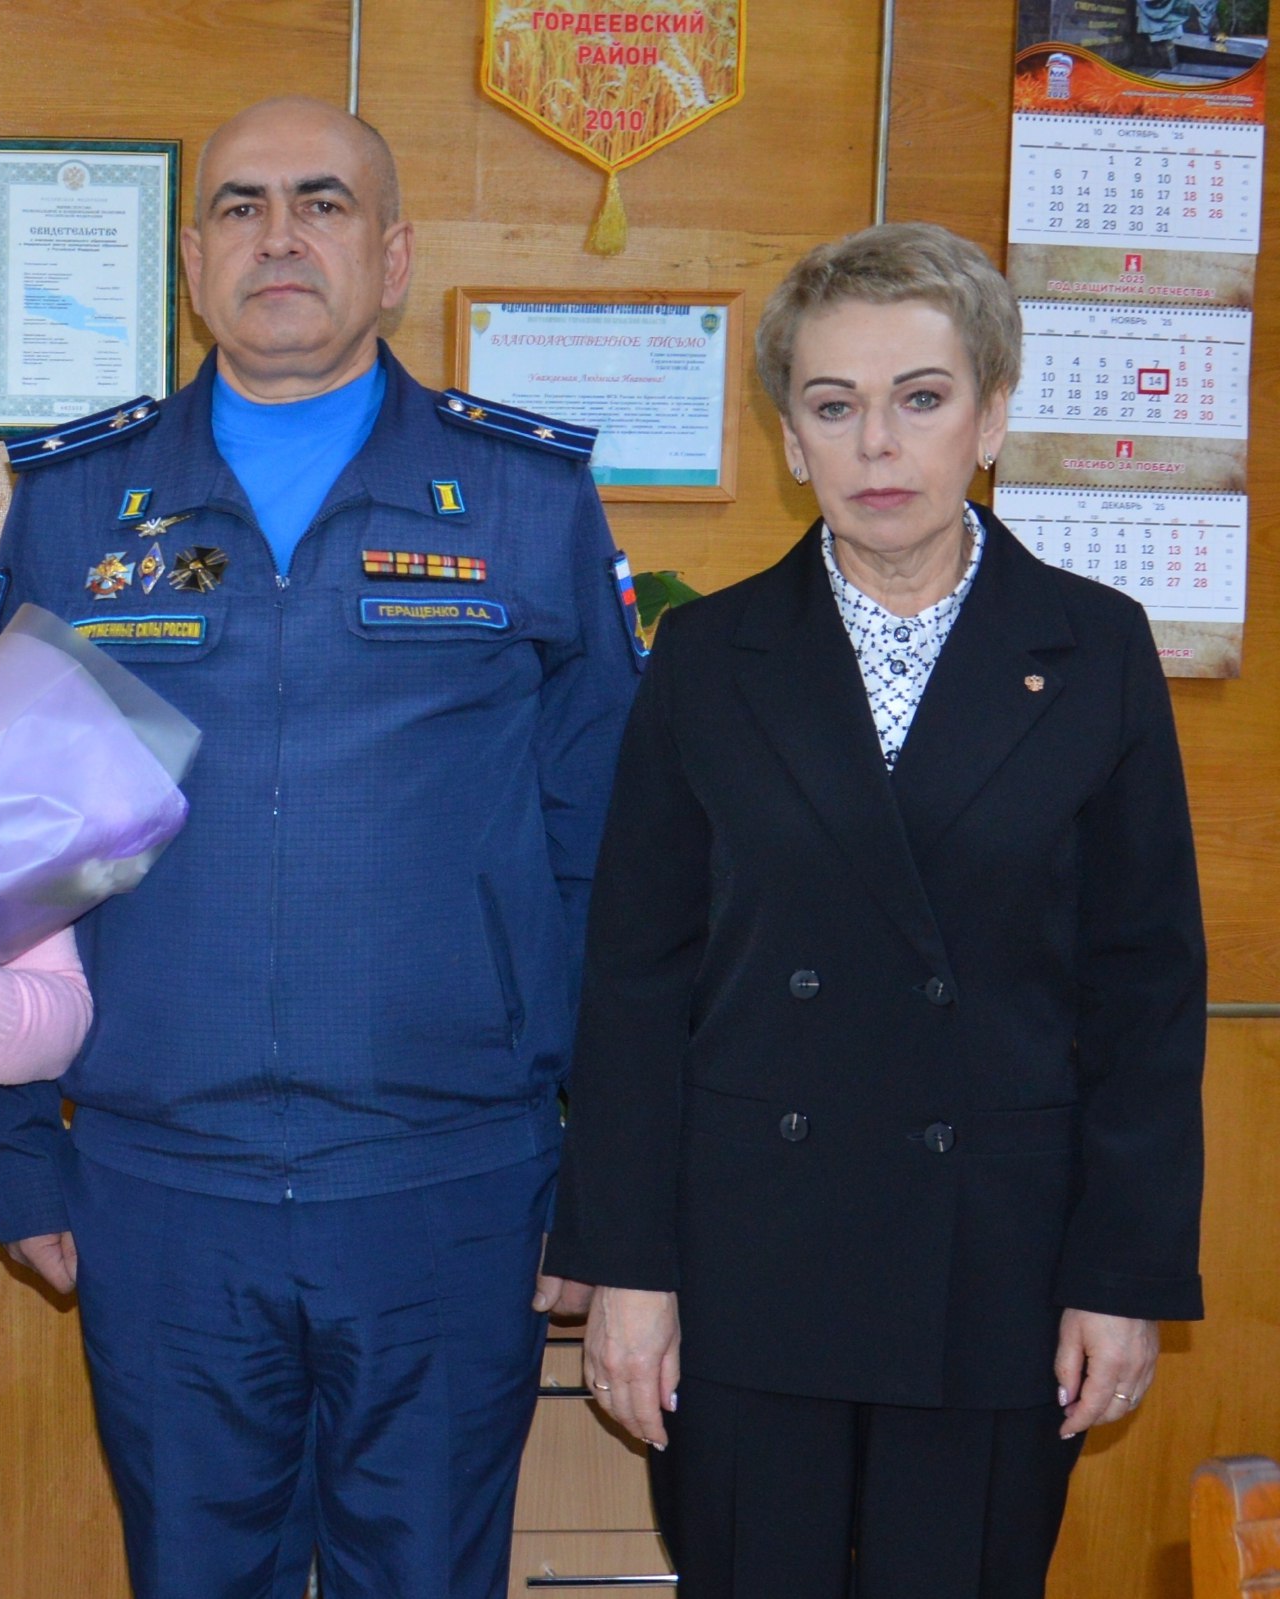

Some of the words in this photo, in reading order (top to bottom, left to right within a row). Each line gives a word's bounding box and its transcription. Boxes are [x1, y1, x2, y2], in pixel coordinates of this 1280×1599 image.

[532, 11, 704, 35] ГОРДЕЕВСКИЙ
[578, 42, 657, 65] РАЙОН
[586, 110, 643, 131] 2010
[1118, 129, 1159, 139] ОКТЯБРЬ
[1109, 156, 1114, 165] 1
[1135, 157, 1142, 166] 2
[1162, 158, 1168, 167] 3
[1188, 160, 1195, 168] 4
[1214, 161, 1222, 170] 5
[1054, 169, 1062, 179] 6
[1082, 170, 1088, 179] 7
[1107, 171, 1115, 181] 8
[1134, 173, 1142, 183] 9
[1158, 174, 1171, 184] 10
[1185, 175, 1196, 185] 11
[1211, 177, 1224, 187] 12
[1051, 185, 1063, 195] 13
[1078, 187, 1090, 196] 14
[1105, 188, 1117, 197] 15
[1131, 189, 1143, 199] 16
[1158, 190, 1170, 200] 17
[1184, 191, 1197, 201] 18
[1210, 193, 1223, 202] 19
[1050, 201, 1064, 211] 20
[1077, 203, 1089, 213] 21
[1103, 204, 1117, 214] 22
[1130, 205, 1143, 215] 23
[1156, 206, 1170, 216] 24
[1183, 208, 1197, 217] 25
[1209, 209, 1223, 218] 26
[30, 227, 118, 236] СВИДЕТЕЛЬСТВО
[1049, 217, 1063, 227] 27
[1076, 219, 1089, 229] 28
[1102, 220, 1116, 230] 29
[1129, 221, 1143, 231] 30
[1156, 222, 1168, 232] 31
[1120, 275, 1144, 284] 2025
[1048, 281, 1070, 292] ГОД
[1074, 282, 1144, 295] ЗАЩИТНИКА
[1148, 286, 1215, 298] ОТЕЧЕСТВА!
[1111, 316, 1147, 325] НОЯБРЬ
[491, 334, 641, 348] БЛАГОДАРСТВЕННОЕ
[647, 336, 706, 348] ПИСЬМО
[1180, 346, 1185, 355] 1
[1206, 347, 1213, 356] 2
[1046, 356, 1053, 365] 3
[1073, 357, 1080, 366] 4
[1100, 358, 1106, 367] 5
[1126, 359, 1133, 368] 6
[1179, 361, 1186, 371] 8
[1205, 362, 1212, 372] 9
[528, 373, 578, 384] Уважаемая
[578, 374, 620, 383] Людмила
[1042, 372, 1055, 382] 10
[1070, 373, 1081, 383] 11
[1096, 374, 1108, 384] 12
[1123, 376, 1135, 386] 13
[1148, 376, 1162, 386] 14
[1176, 378, 1188, 387] 15
[1202, 379, 1214, 388] 16
[1041, 388, 1054, 398] 17
[1068, 389, 1081, 399] 18
[1095, 390, 1108, 400] 19
[1121, 392, 1136, 402] 20
[1174, 393, 1188, 403] 22
[1200, 395, 1214, 405] 23
[1039, 405, 1054, 414] 24
[1067, 406, 1081, 415] 25
[1093, 407, 1108, 416] 26
[1120, 407, 1134, 417] 27
[1147, 408, 1161, 418] 28
[1174, 410, 1188, 419] 29
[1200, 411, 1214, 420] 30
[1063, 459, 1115, 470] СПАСИБО
[1119, 461, 1133, 471] ЗА
[1136, 462, 1184, 473] ПОБЕДУ!
[1101, 501, 1142, 511] ДЕКАБРЬ
[1038, 526, 1043, 535] 1
[1064, 527, 1071, 536] 2
[1091, 527, 1098, 537] 3
[1118, 529, 1125, 537] 4
[1145, 529, 1151, 538] 5
[1171, 530, 1178, 539] 6
[1198, 530, 1205, 540] 7
[1036, 542, 1044, 551] 8
[1064, 542, 1071, 552] 9
[1088, 543, 1101, 553] 10
[1116, 544, 1126, 553] 11
[1142, 545, 1154, 554] 12
[1169, 546, 1181, 555] 13
[1195, 546, 1207, 556] 14
[1061, 558, 1073, 568] 16
[1088, 559, 1100, 569] 17
[1115, 560, 1127, 569] 18
[1142, 561, 1154, 570] 19
[1167, 562, 1181, 571] 20
[1195, 562, 1207, 572] 21
[1113, 576, 1127, 586] 25
[1140, 577, 1154, 586] 26
[1167, 577, 1180, 587] 27
[1193, 578, 1207, 588] 28
[378, 605, 459, 619] ГЕРАЩЕНКО
[466, 607, 491, 619] А.А.
[136, 623, 161, 638] СИЛЫ
[163, 622, 200, 638] РОССИИ
